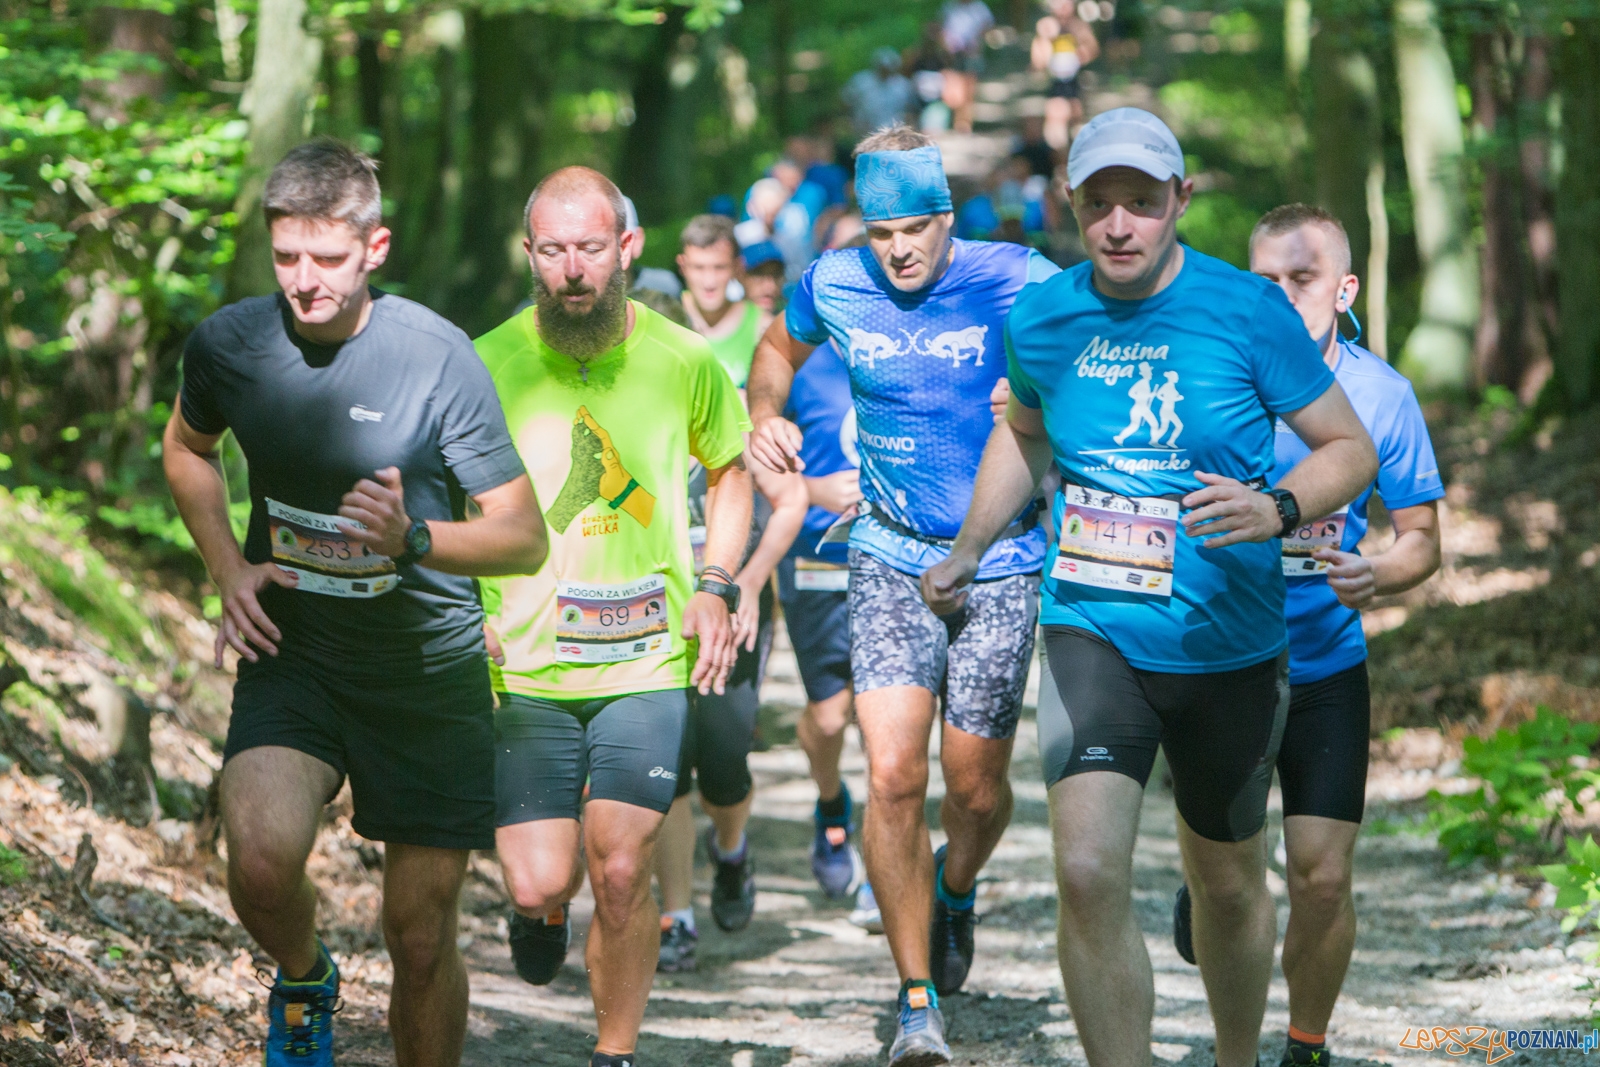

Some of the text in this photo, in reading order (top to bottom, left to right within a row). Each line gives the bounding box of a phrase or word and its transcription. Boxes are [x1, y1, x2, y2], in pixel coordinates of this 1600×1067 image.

[1073, 336, 1170, 365] Mosina
[1077, 355, 1135, 386] biega
[582, 522, 619, 538] WILKA
[1092, 517, 1133, 546] 141
[305, 535, 351, 561] 253
[567, 579, 658, 598] POGOŃ ZA WILKIEM
[599, 605, 630, 627] 69
